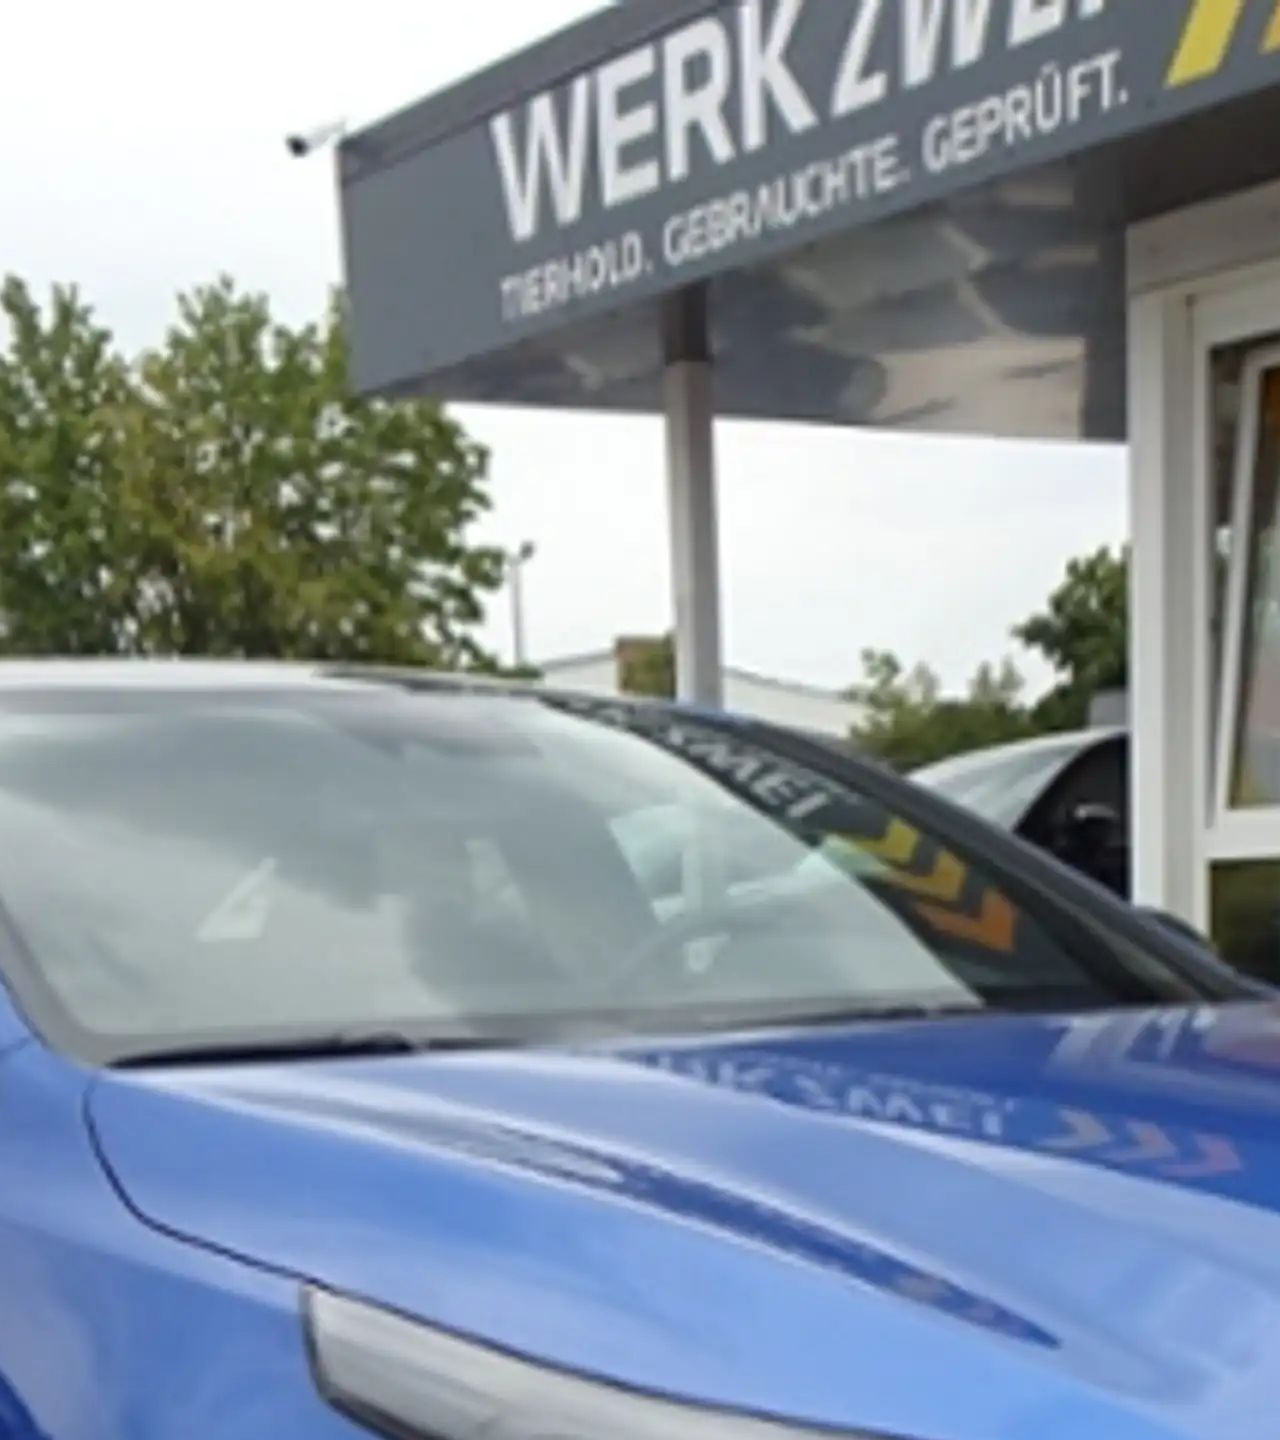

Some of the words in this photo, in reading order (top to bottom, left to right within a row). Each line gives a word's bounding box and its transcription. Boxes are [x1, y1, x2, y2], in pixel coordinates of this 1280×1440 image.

[489, 0, 819, 242] WERK
[829, 0, 1105, 119] ZW
[921, 48, 1130, 174] GEPRÜFT.
